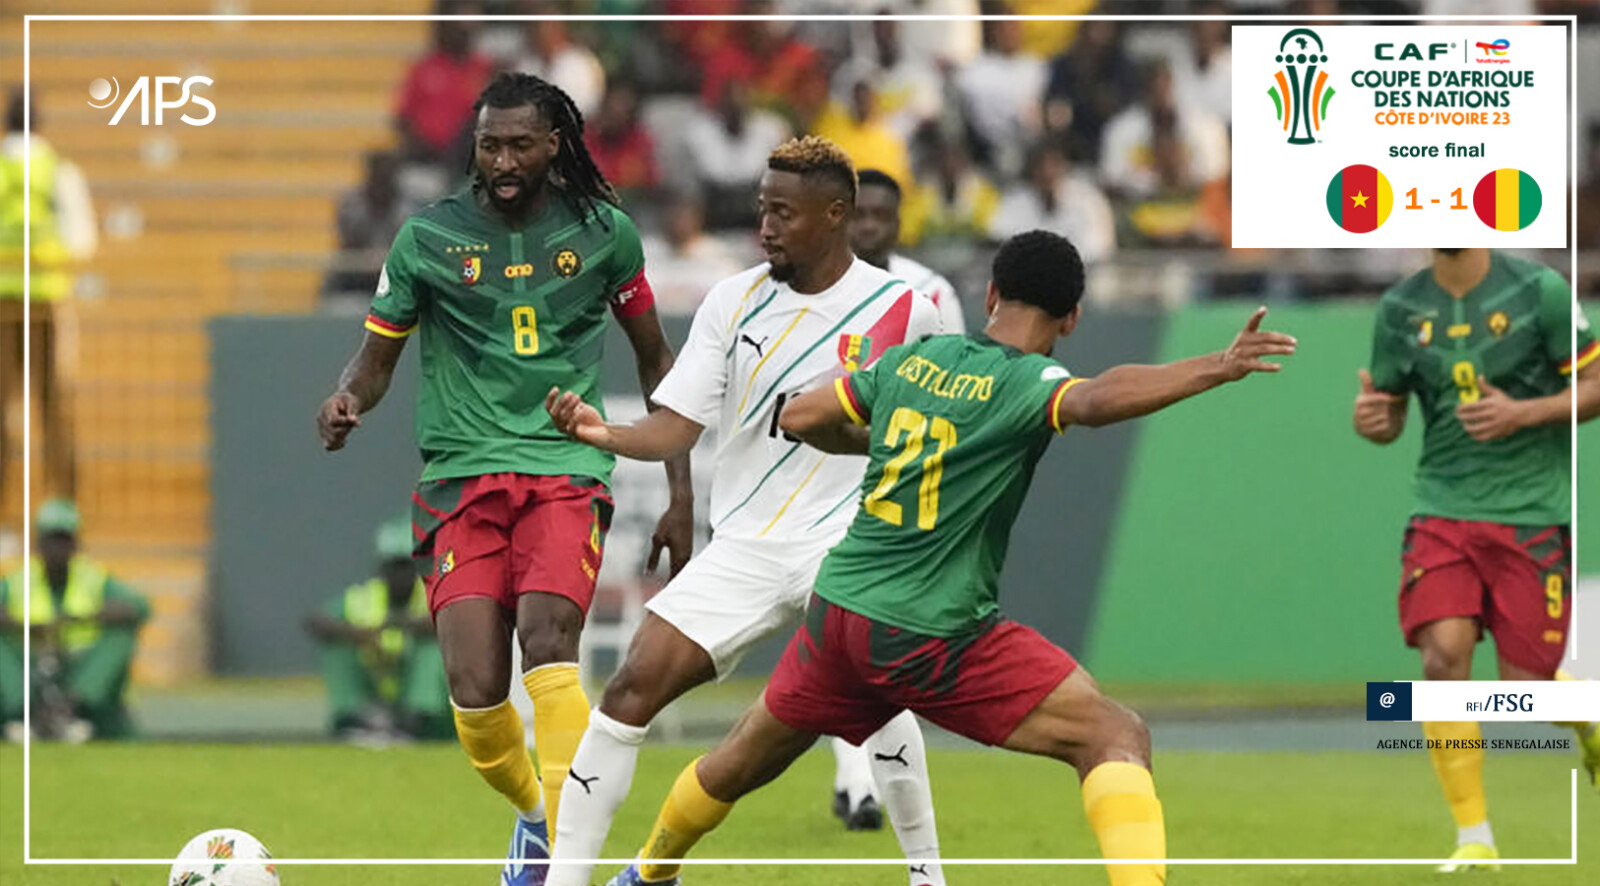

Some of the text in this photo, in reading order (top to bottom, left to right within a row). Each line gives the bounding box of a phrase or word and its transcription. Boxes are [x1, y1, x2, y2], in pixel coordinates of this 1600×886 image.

[512, 306, 539, 355] 8
[1453, 361, 1480, 405] 9
[864, 406, 957, 531] 21
[1545, 573, 1563, 619] 9
